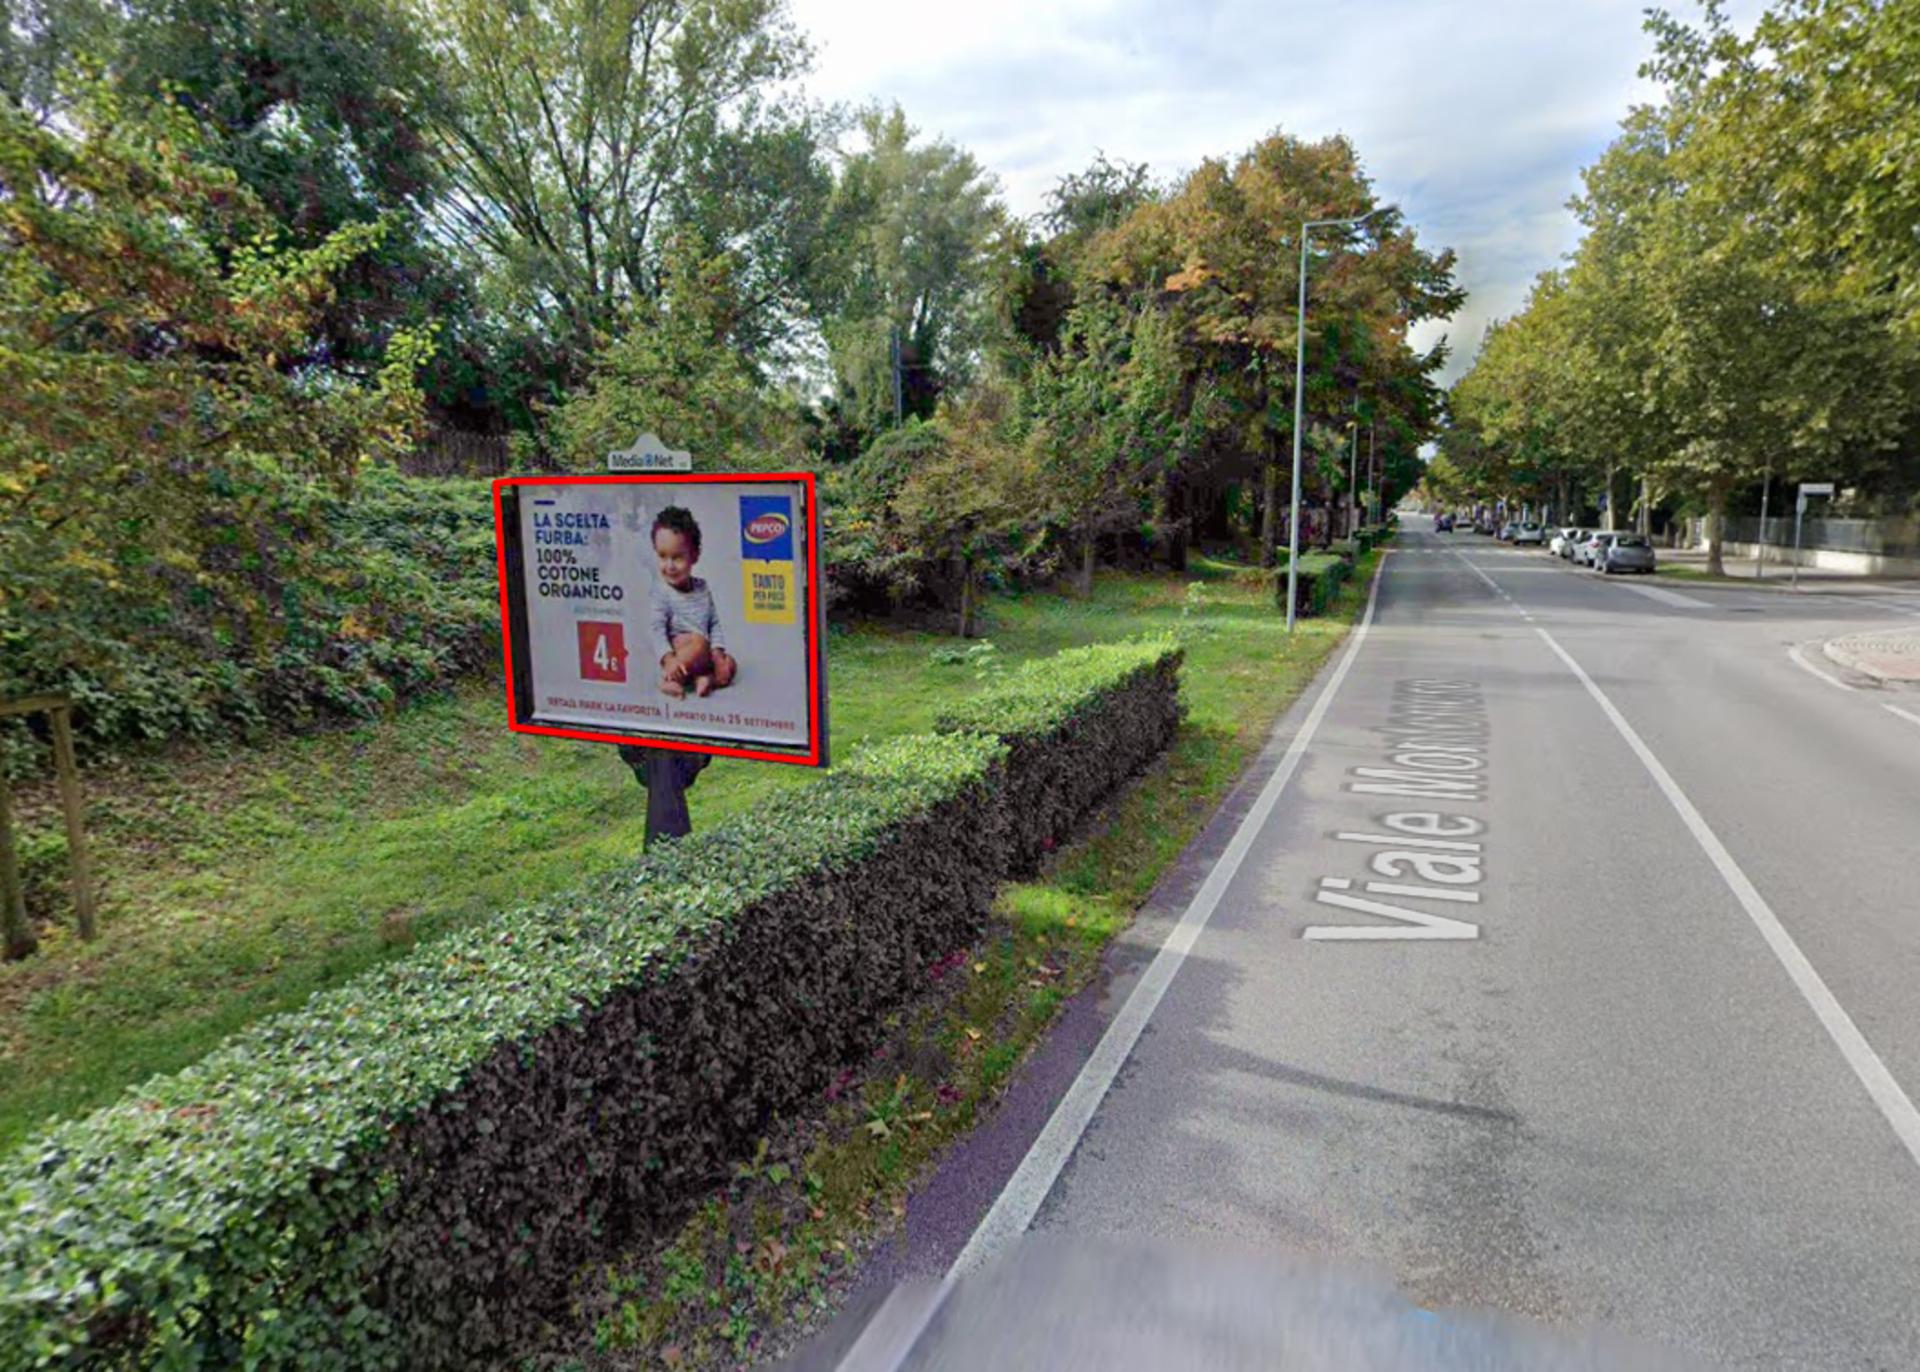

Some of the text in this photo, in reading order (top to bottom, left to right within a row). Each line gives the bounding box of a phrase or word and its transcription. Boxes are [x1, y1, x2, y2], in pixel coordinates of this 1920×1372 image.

[533, 512, 611, 529] LA SCELTA
[535, 529, 588, 546] FURBA:
[536, 548, 577, 565] 100%
[537, 565, 600, 583] COTONE
[539, 582, 624, 601] ORGANICO
[728, 713, 741, 726] 25
